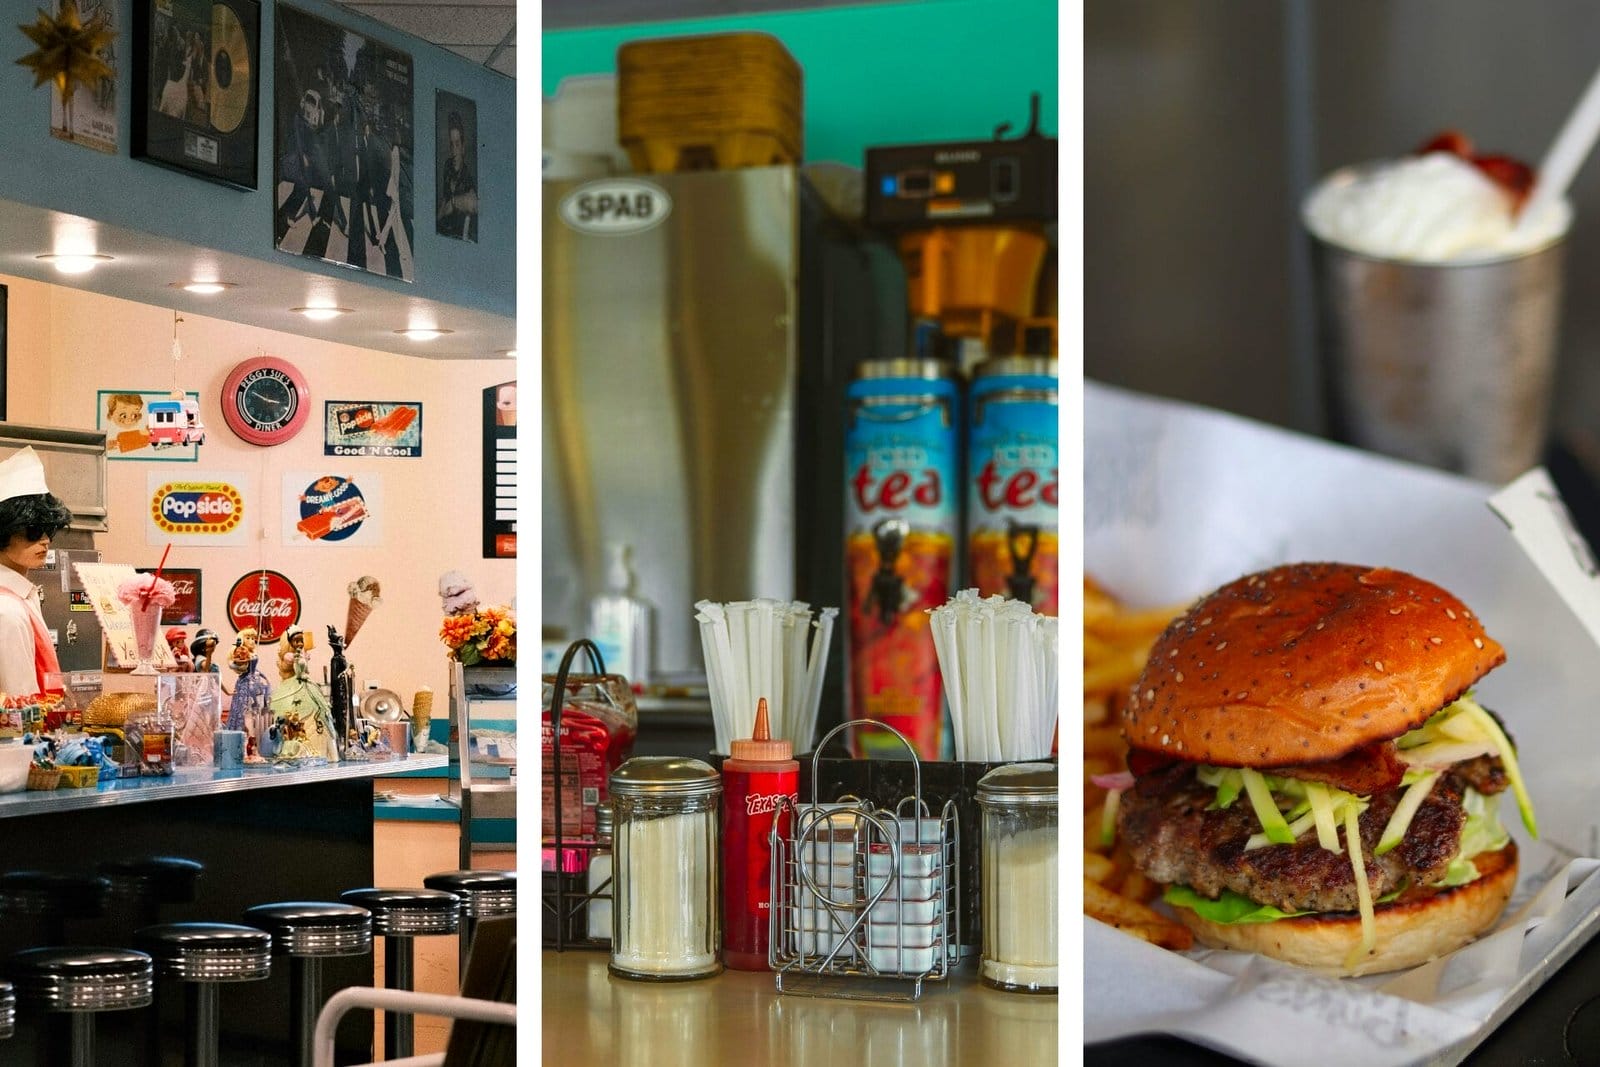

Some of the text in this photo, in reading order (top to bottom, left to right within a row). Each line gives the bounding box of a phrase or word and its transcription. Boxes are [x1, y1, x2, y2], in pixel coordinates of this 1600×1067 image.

[576, 192, 654, 221] SPAB
[241, 370, 290, 388] PEGGY SUE'S
[255, 422, 283, 432] DINER
[334, 446, 365, 455] Good
[384, 447, 412, 456] Cool
[852, 463, 940, 514] tea
[163, 496, 233, 518] Popsicle
